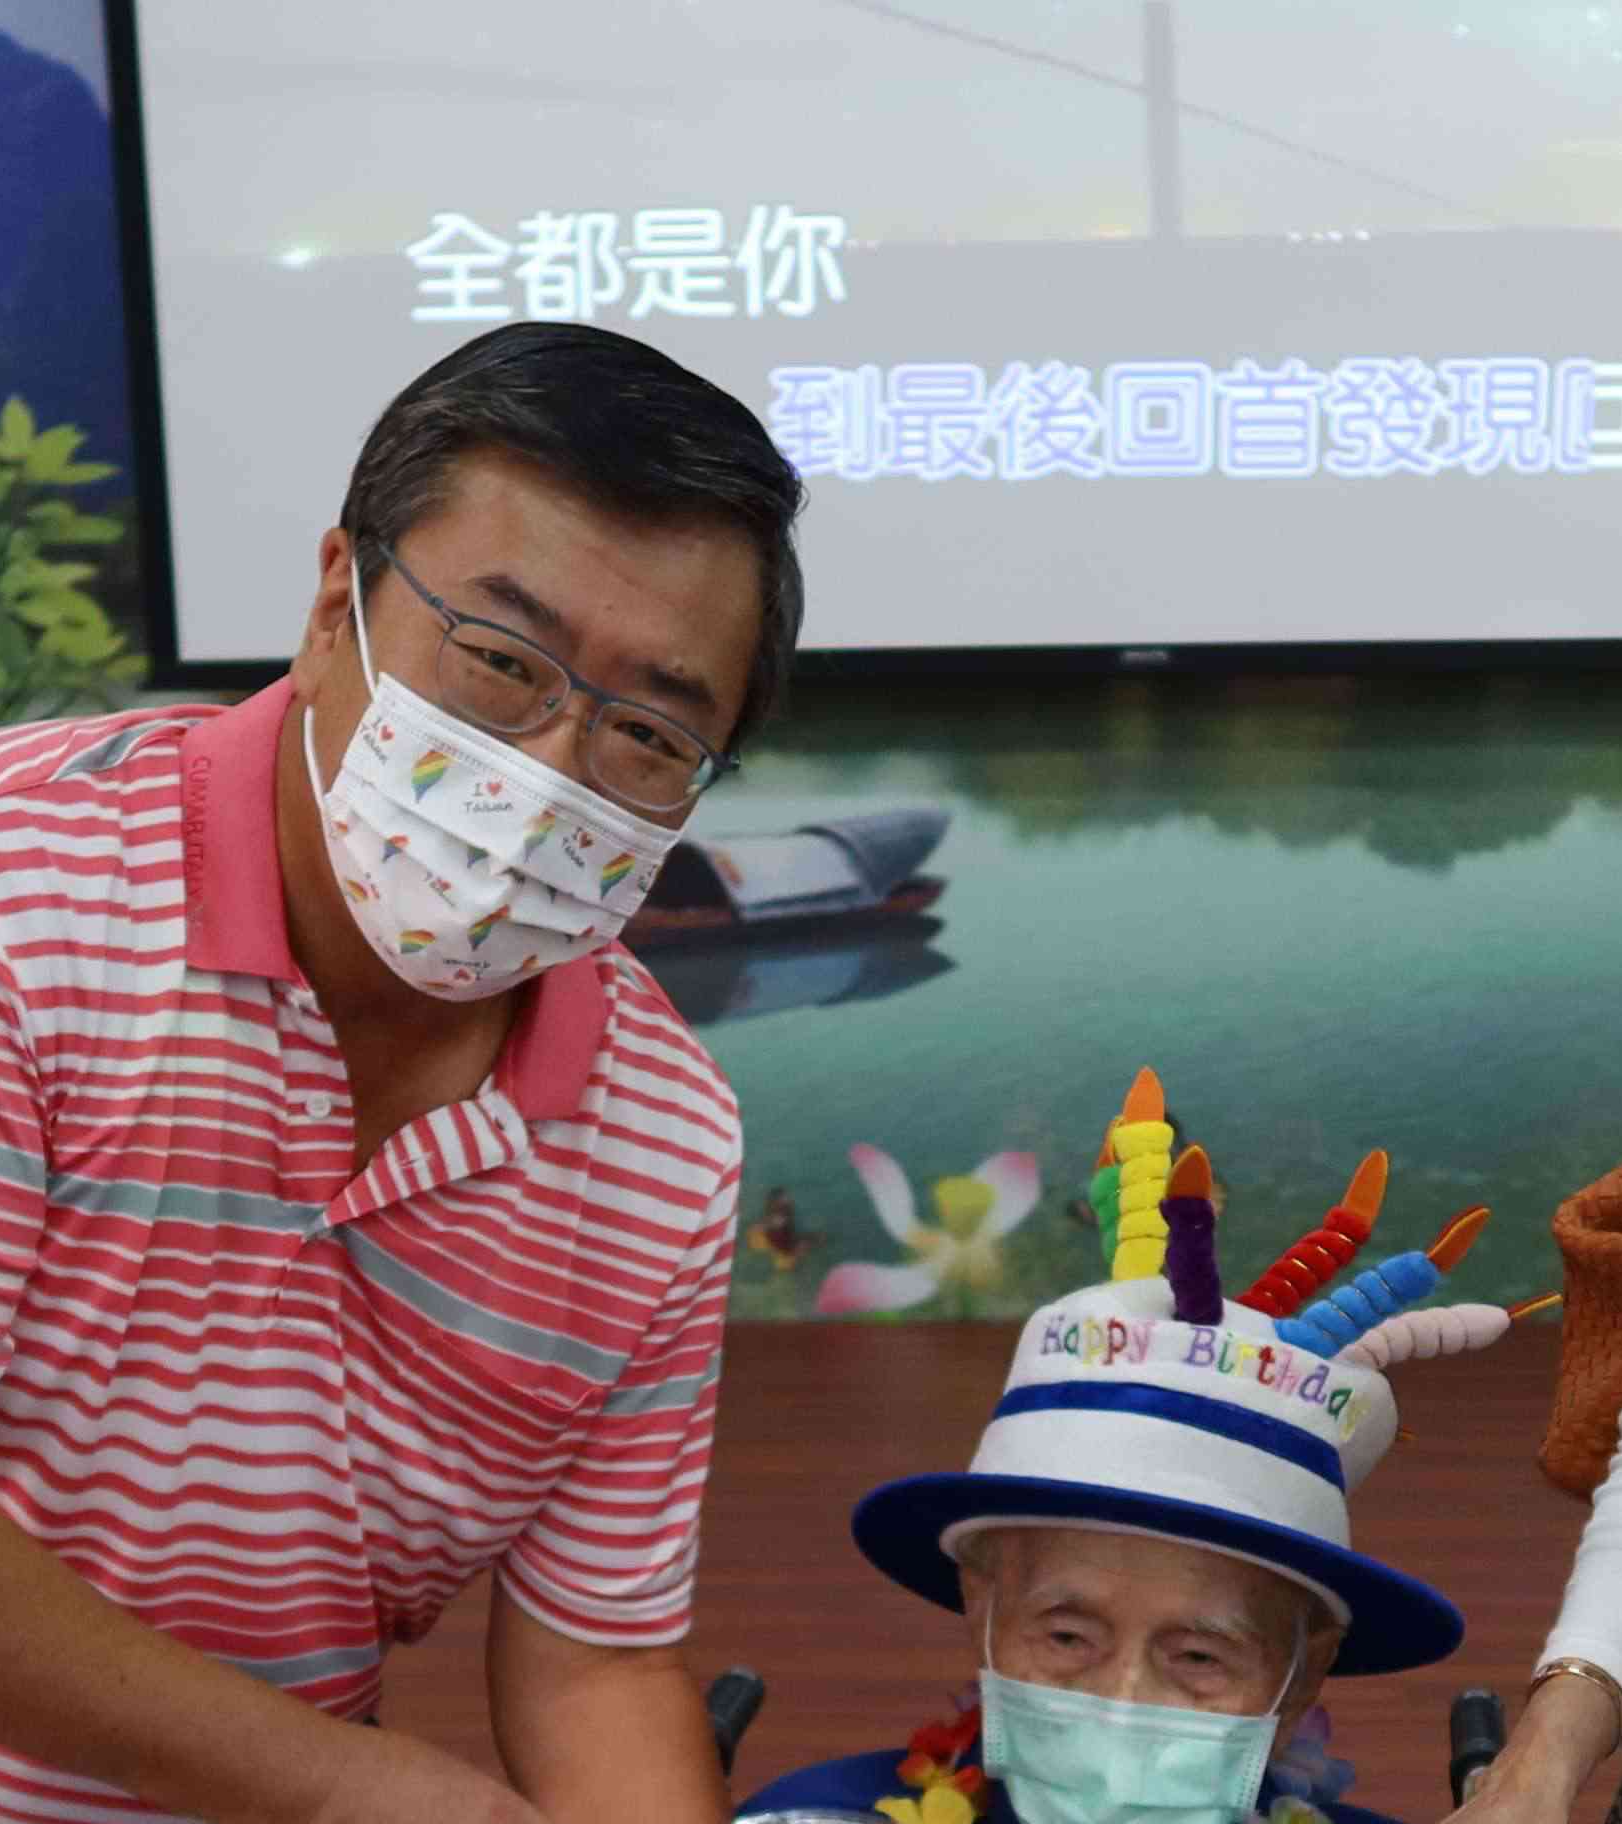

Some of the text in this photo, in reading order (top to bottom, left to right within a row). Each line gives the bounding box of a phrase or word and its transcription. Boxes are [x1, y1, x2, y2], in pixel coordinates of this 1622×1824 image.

[405, 203, 848, 321] 全都是你
[1041, 1315, 1372, 1442] Happy Birthday
